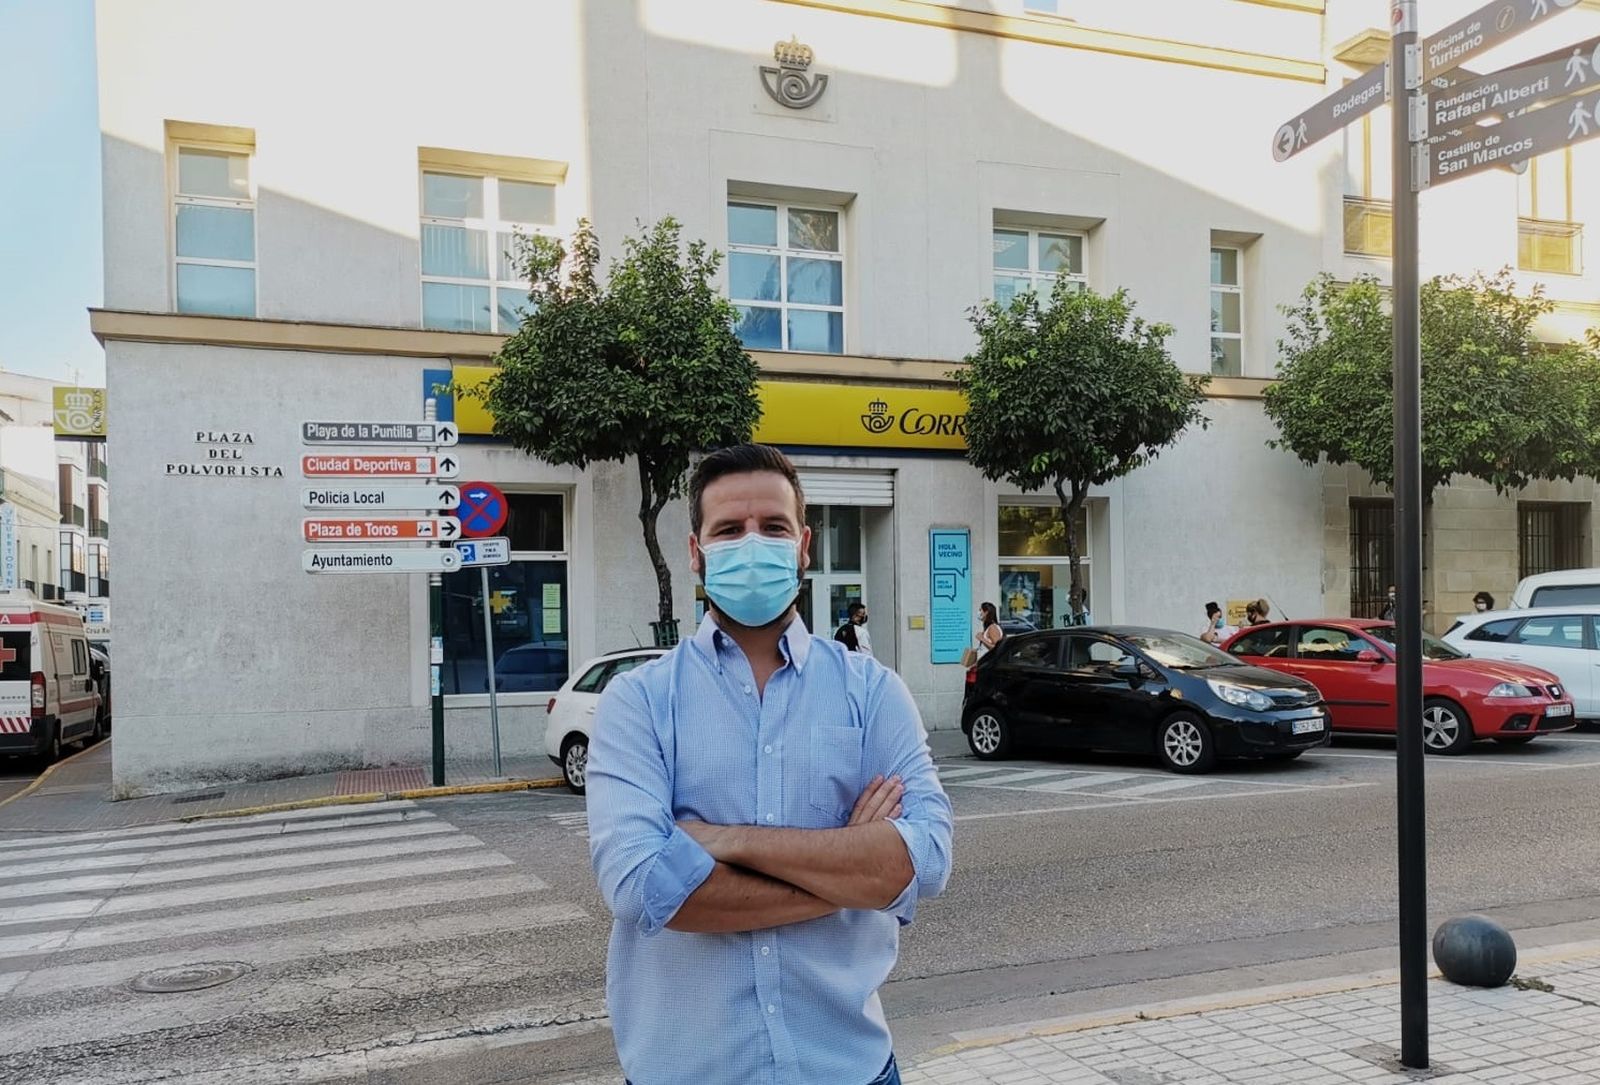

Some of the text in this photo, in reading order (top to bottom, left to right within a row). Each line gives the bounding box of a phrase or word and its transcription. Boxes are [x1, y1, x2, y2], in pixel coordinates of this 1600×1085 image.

[1429, 22, 1481, 55] Oficina de
[1429, 35, 1483, 69] Turismo
[1332, 82, 1383, 118] Bodegas
[1435, 83, 1499, 111] Fundación
[1435, 76, 1549, 125] Rafael Alberti
[1438, 135, 1500, 161] Castillo de
[1438, 138, 1533, 175] San Marcos
[195, 431, 254, 443] PLAZA
[307, 424, 413, 438] Playa de la Puntilla
[209, 449, 242, 459] DEL
[166, 464, 283, 476] POLVORISTA
[307, 459, 411, 473] Ciudad Deportiva
[354, 491, 384, 504] Local
[308, 523, 398, 536] Plaza de Toros
[311, 554, 393, 569] Ayuntamiento
